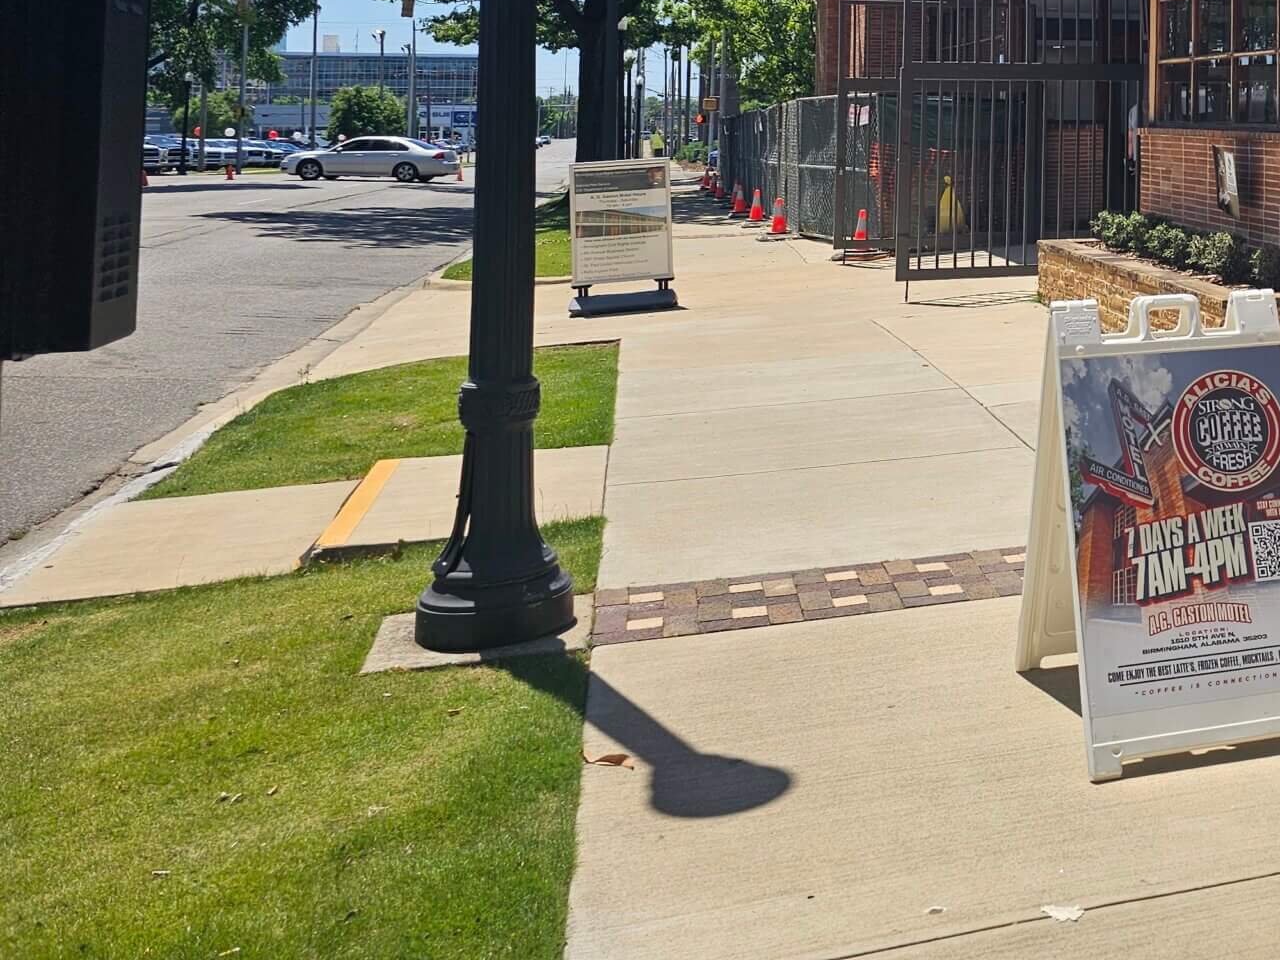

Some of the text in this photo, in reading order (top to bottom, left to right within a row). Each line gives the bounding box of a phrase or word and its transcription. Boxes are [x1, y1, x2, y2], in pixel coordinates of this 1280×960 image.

[1183, 373, 1271, 410] ALICIA'S
[1198, 397, 1255, 415] STRONG
[1195, 409, 1263, 447] COFFEE
[1198, 459, 1271, 488] COFFEE
[1212, 449, 1253, 471] FRESH
[1090, 462, 1150, 495] AIR CONDITIONED
[1125, 502, 1247, 559] 7 DAYS A WEEK
[1132, 532, 1249, 601] 7AM-4PM
[1149, 603, 1253, 636] A.G. GASTON MOTEL
[1200, 637, 1241, 648] ALABAMA
[1210, 632, 1227, 640] AVE
[1107, 669, 1125, 683] COME
[1126, 667, 1145, 681] ENJOY
[1146, 666, 1157, 679] THE
[1157, 663, 1172, 676] BEST
[1198, 658, 1219, 671] FROZEN
